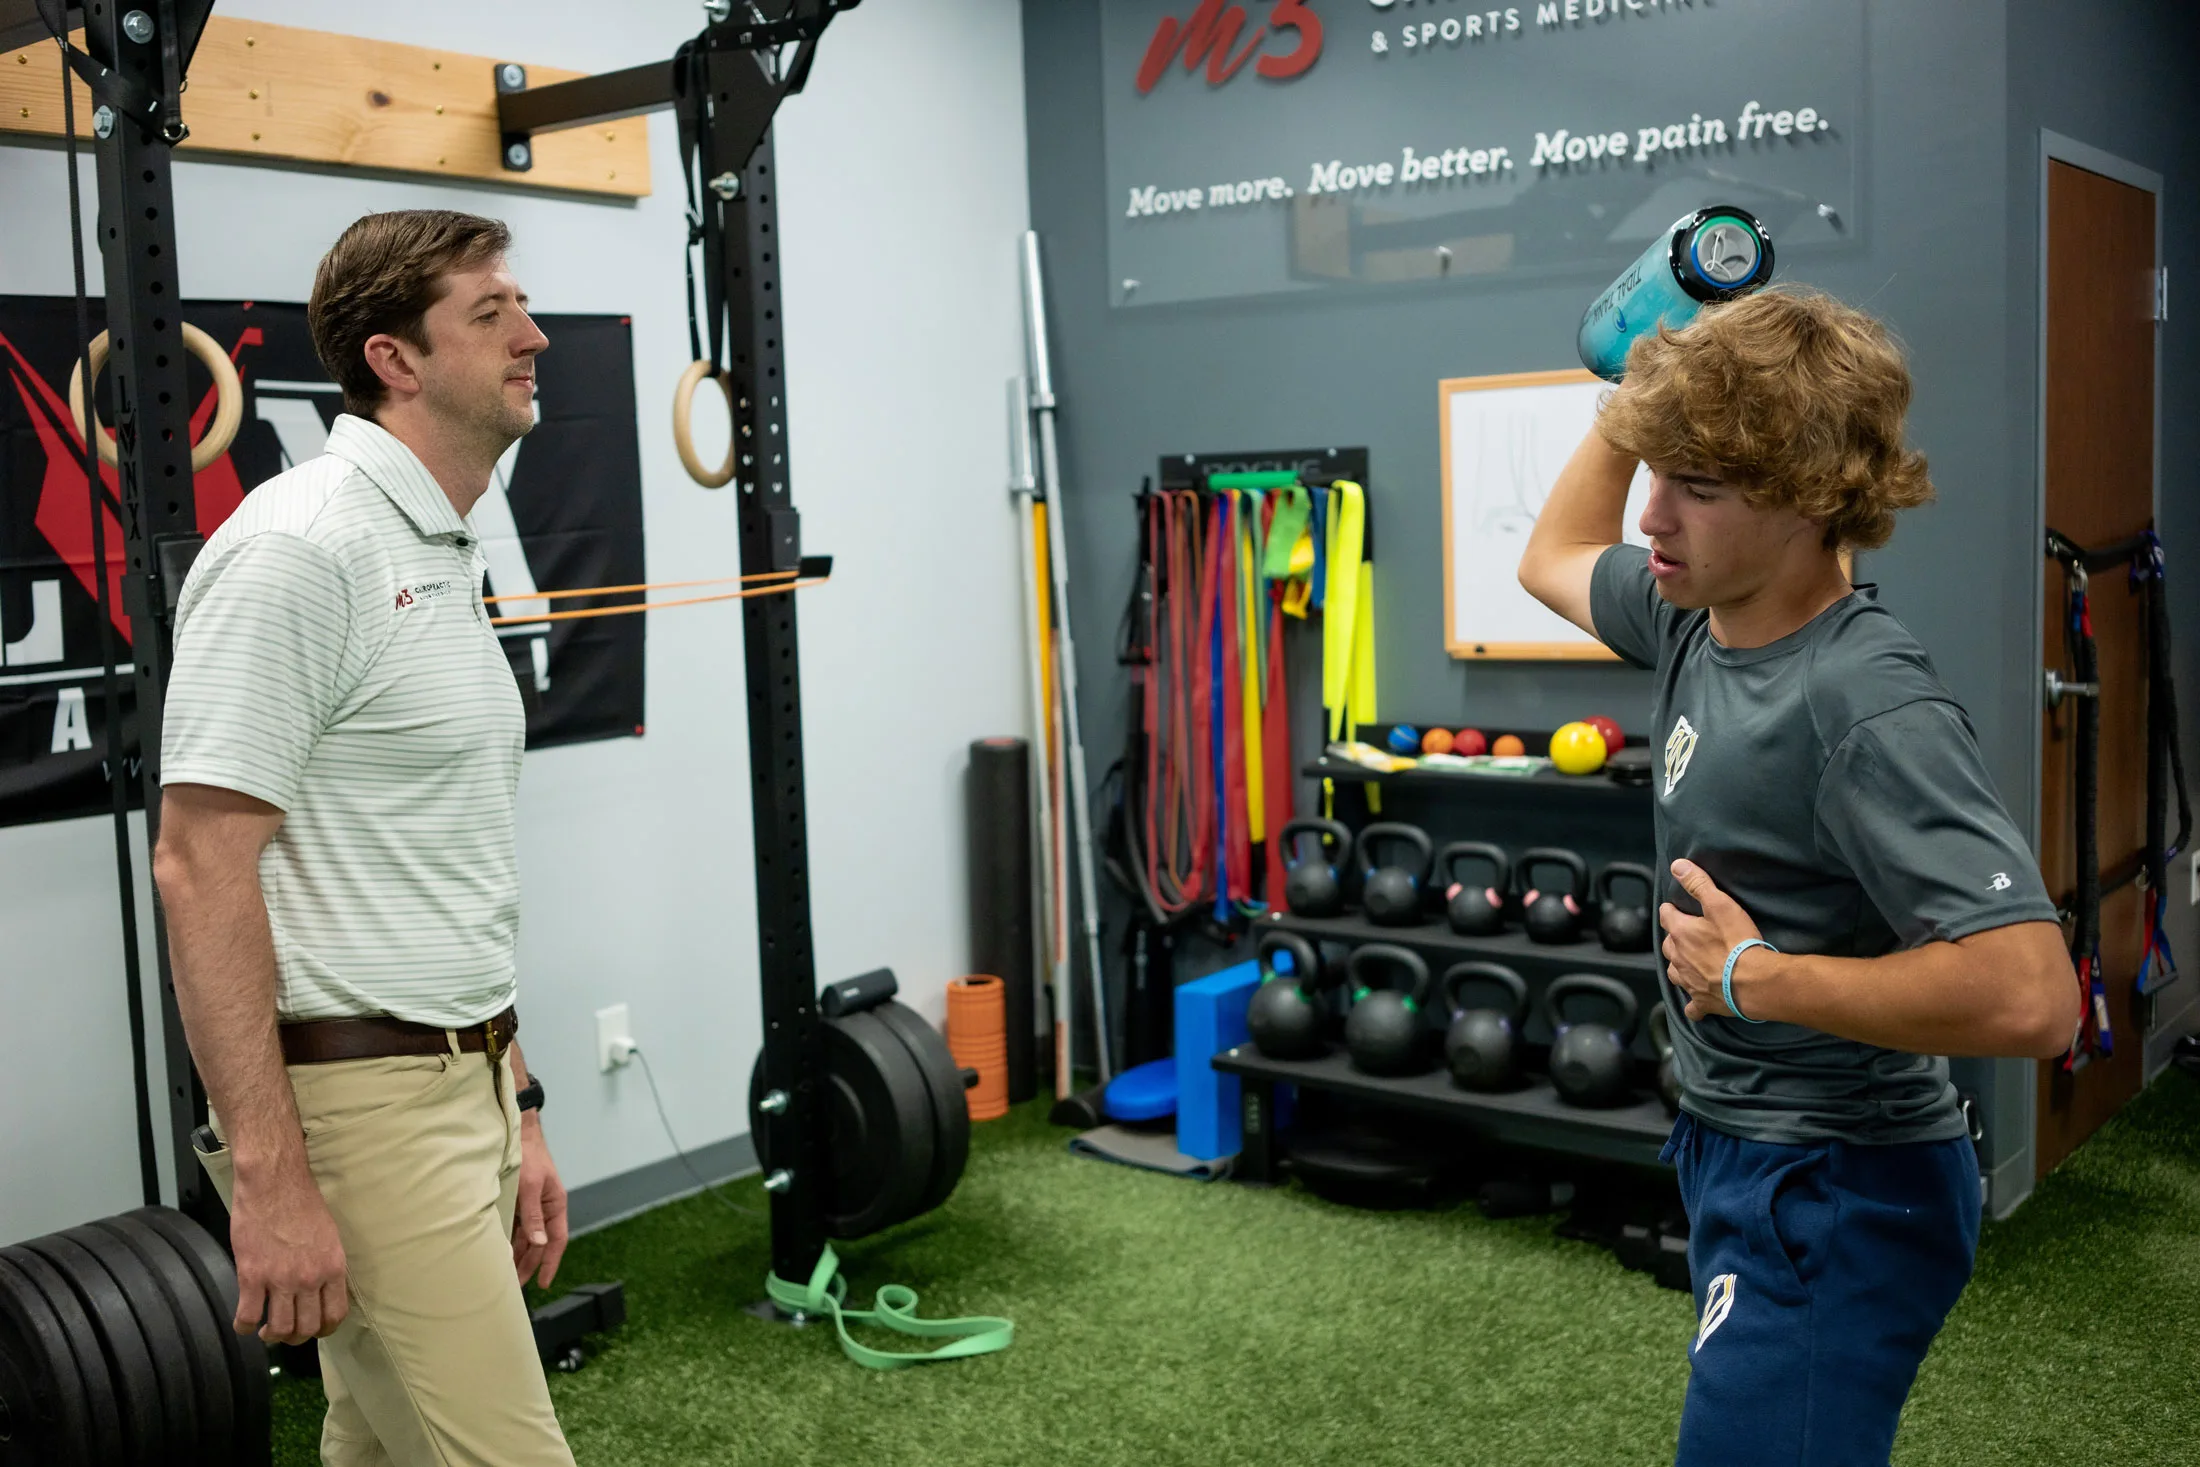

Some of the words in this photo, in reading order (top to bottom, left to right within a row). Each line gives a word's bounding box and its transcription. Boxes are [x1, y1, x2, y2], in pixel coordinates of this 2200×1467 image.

[1371, 30, 1389, 53] &
[1402, 8, 1520, 48] SPORTS
[1126, 184, 1203, 217] Move
[1208, 176, 1294, 207] more.
[1307, 160, 1395, 194] Move
[1400, 146, 1514, 182] better.
[1530, 128, 1629, 166] Move
[1633, 113, 1727, 162] pain
[1737, 100, 1829, 140] free.
